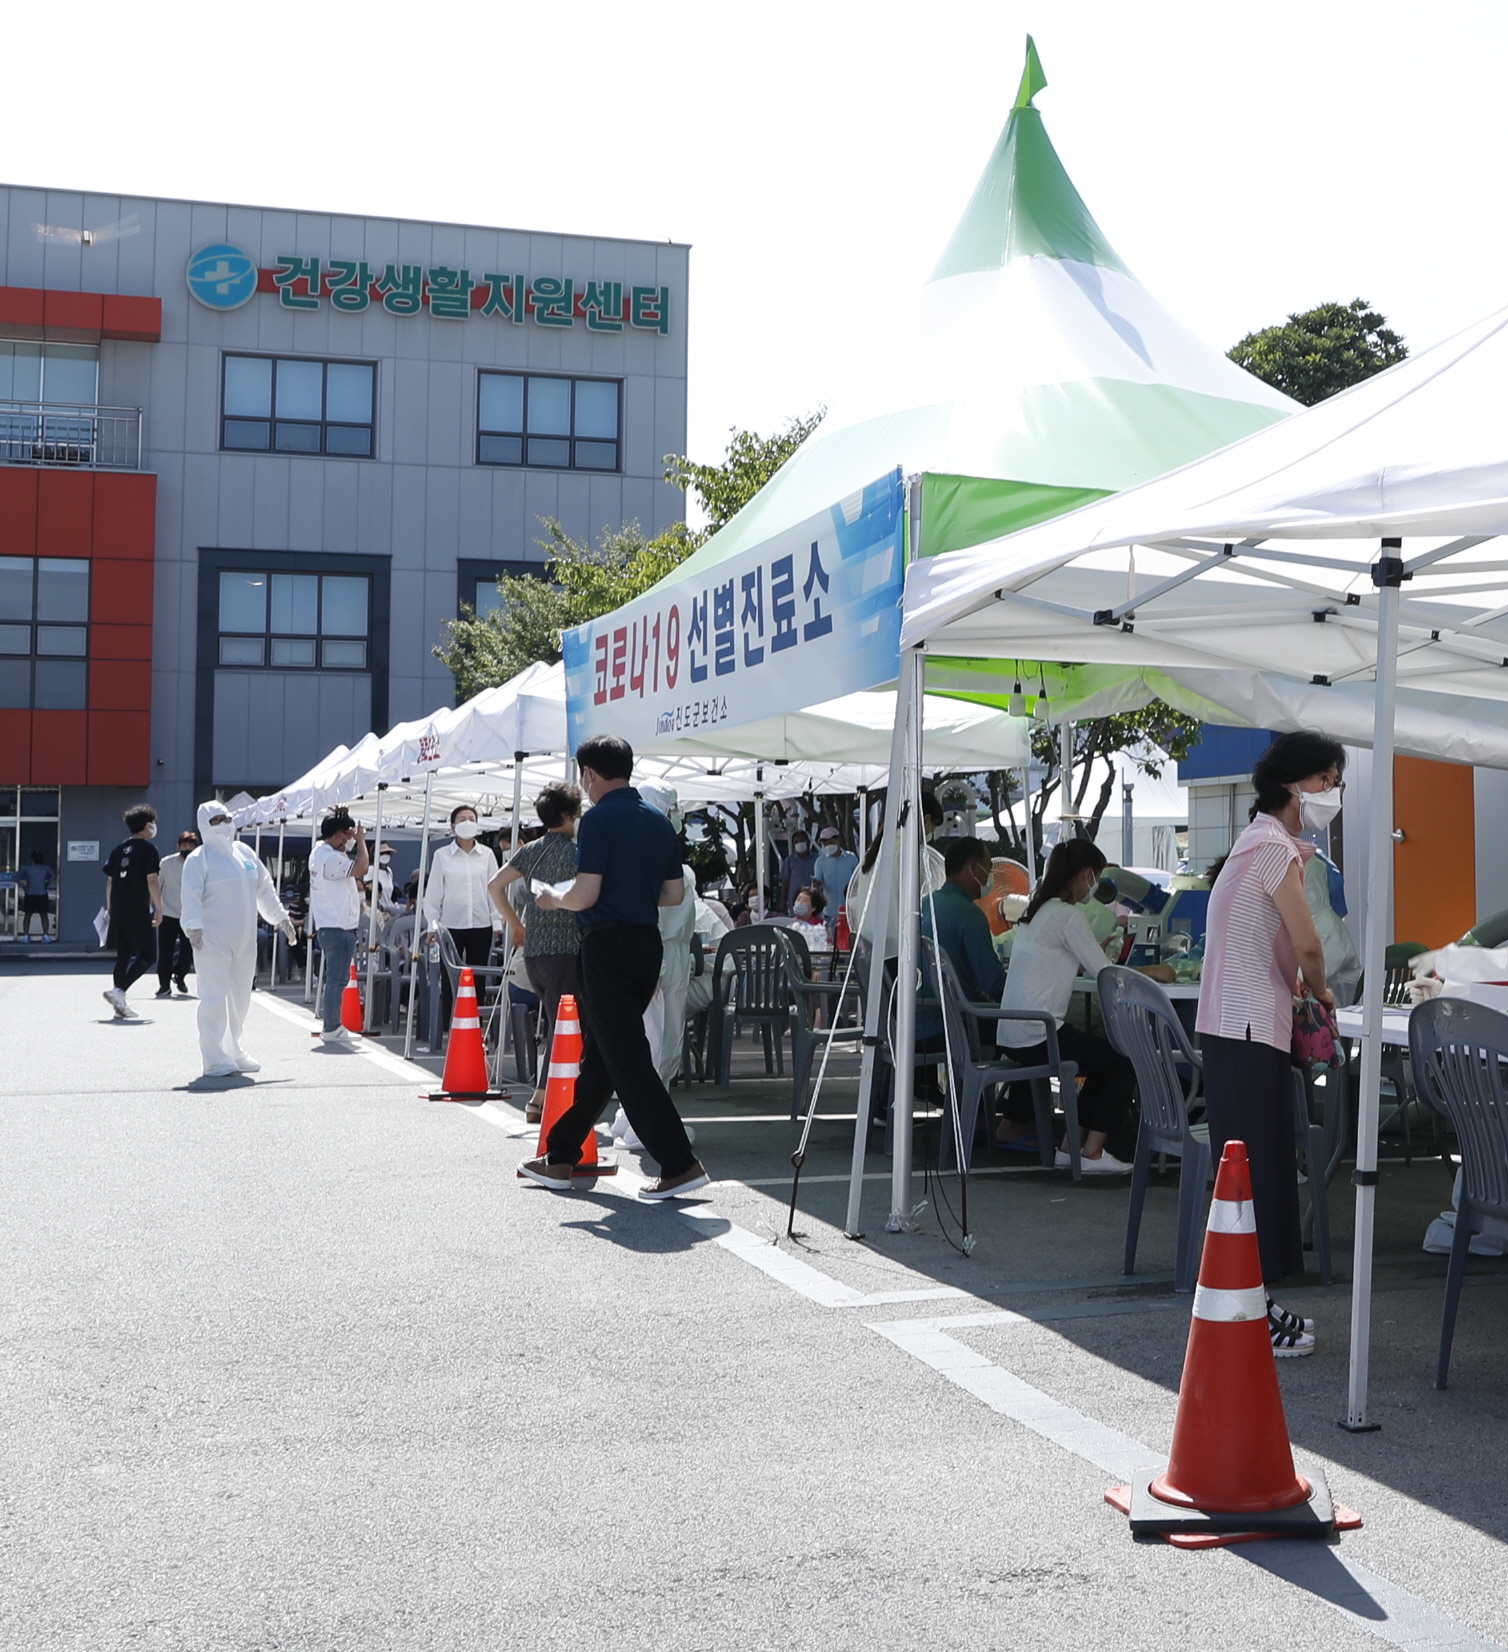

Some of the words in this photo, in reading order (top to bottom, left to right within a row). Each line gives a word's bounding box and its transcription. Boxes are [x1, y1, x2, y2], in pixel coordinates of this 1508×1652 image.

[274, 255, 670, 335] 건강생활지원센터
[593, 604, 681, 706] 코로나19
[687, 540, 833, 684] 선별진료소
[676, 695, 727, 731] 진도군보건소
